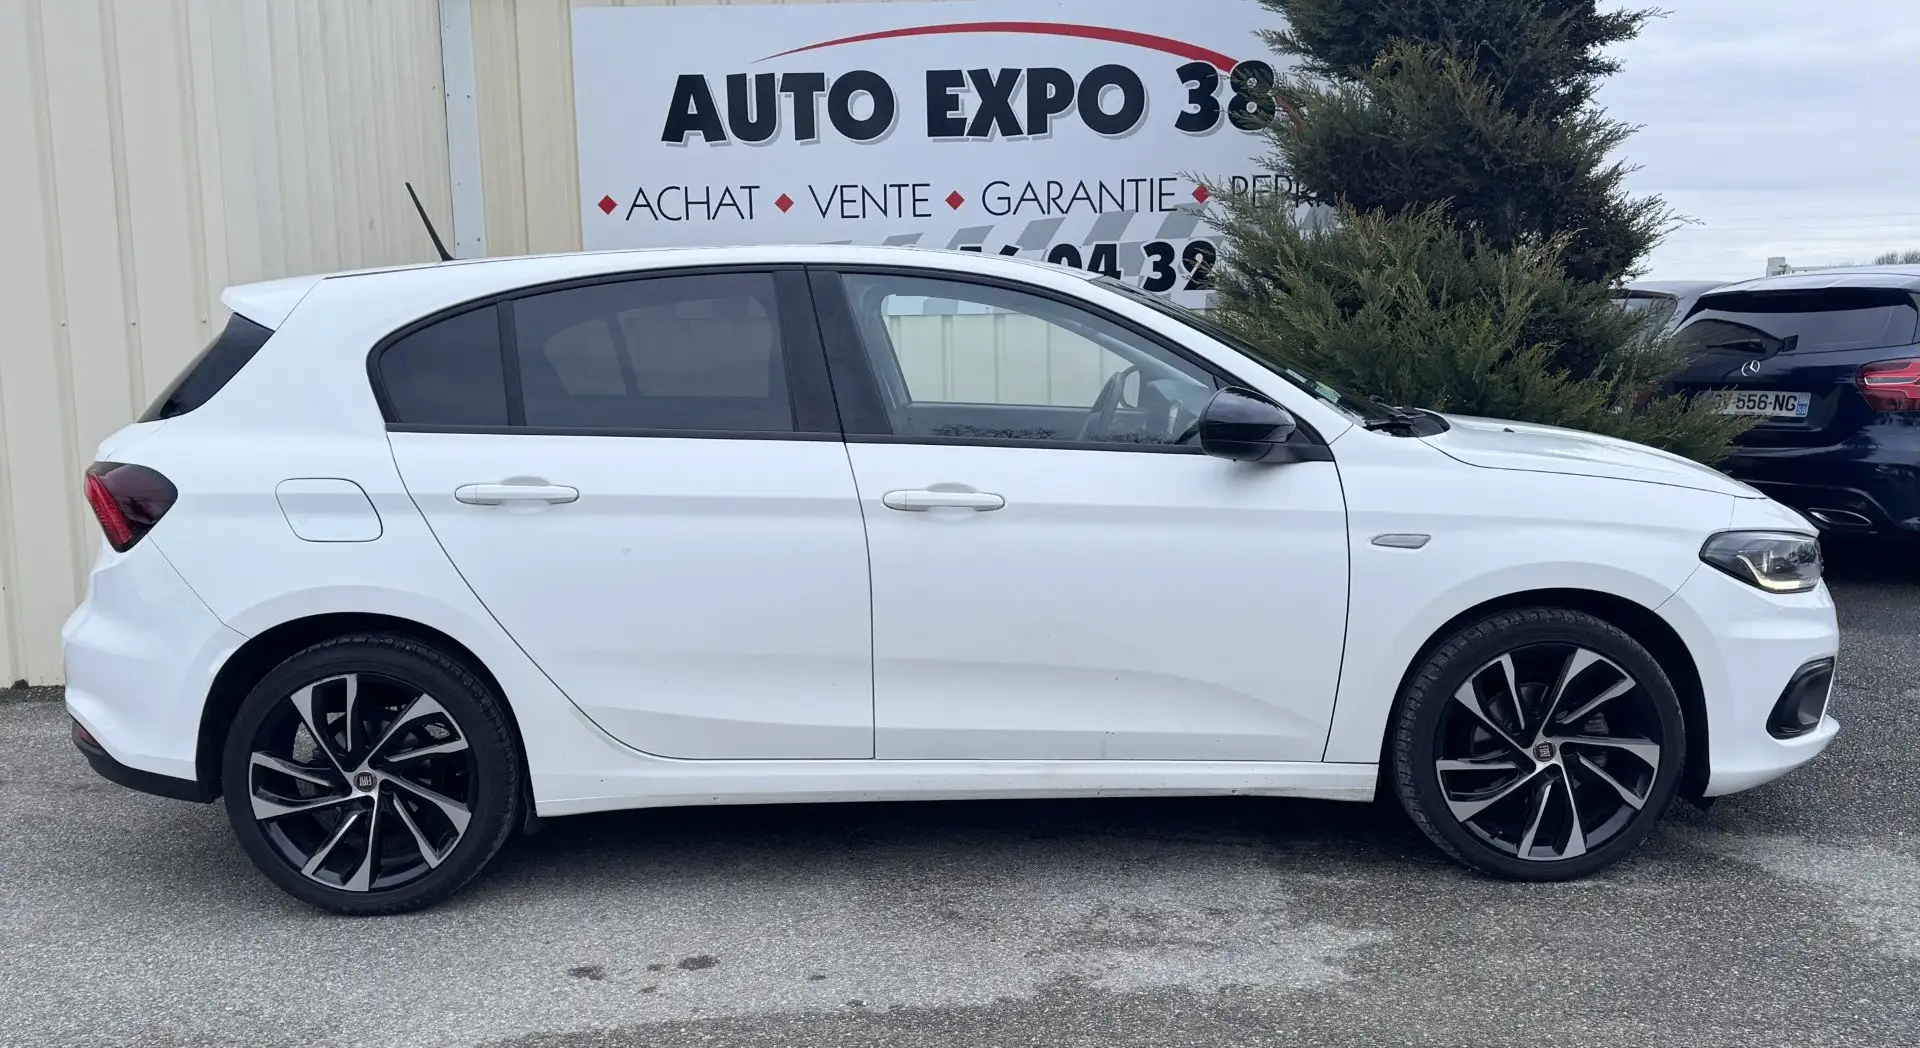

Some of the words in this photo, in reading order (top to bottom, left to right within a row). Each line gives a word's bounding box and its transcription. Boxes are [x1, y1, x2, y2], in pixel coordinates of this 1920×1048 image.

[660, 68, 897, 145] AUTO
[924, 63, 1146, 140] EXPO
[1174, 59, 1276, 133] 38
[625, 184, 760, 221] ACHAT
[807, 182, 932, 219] VENTE
[981, 177, 1178, 216] GARANTIE
